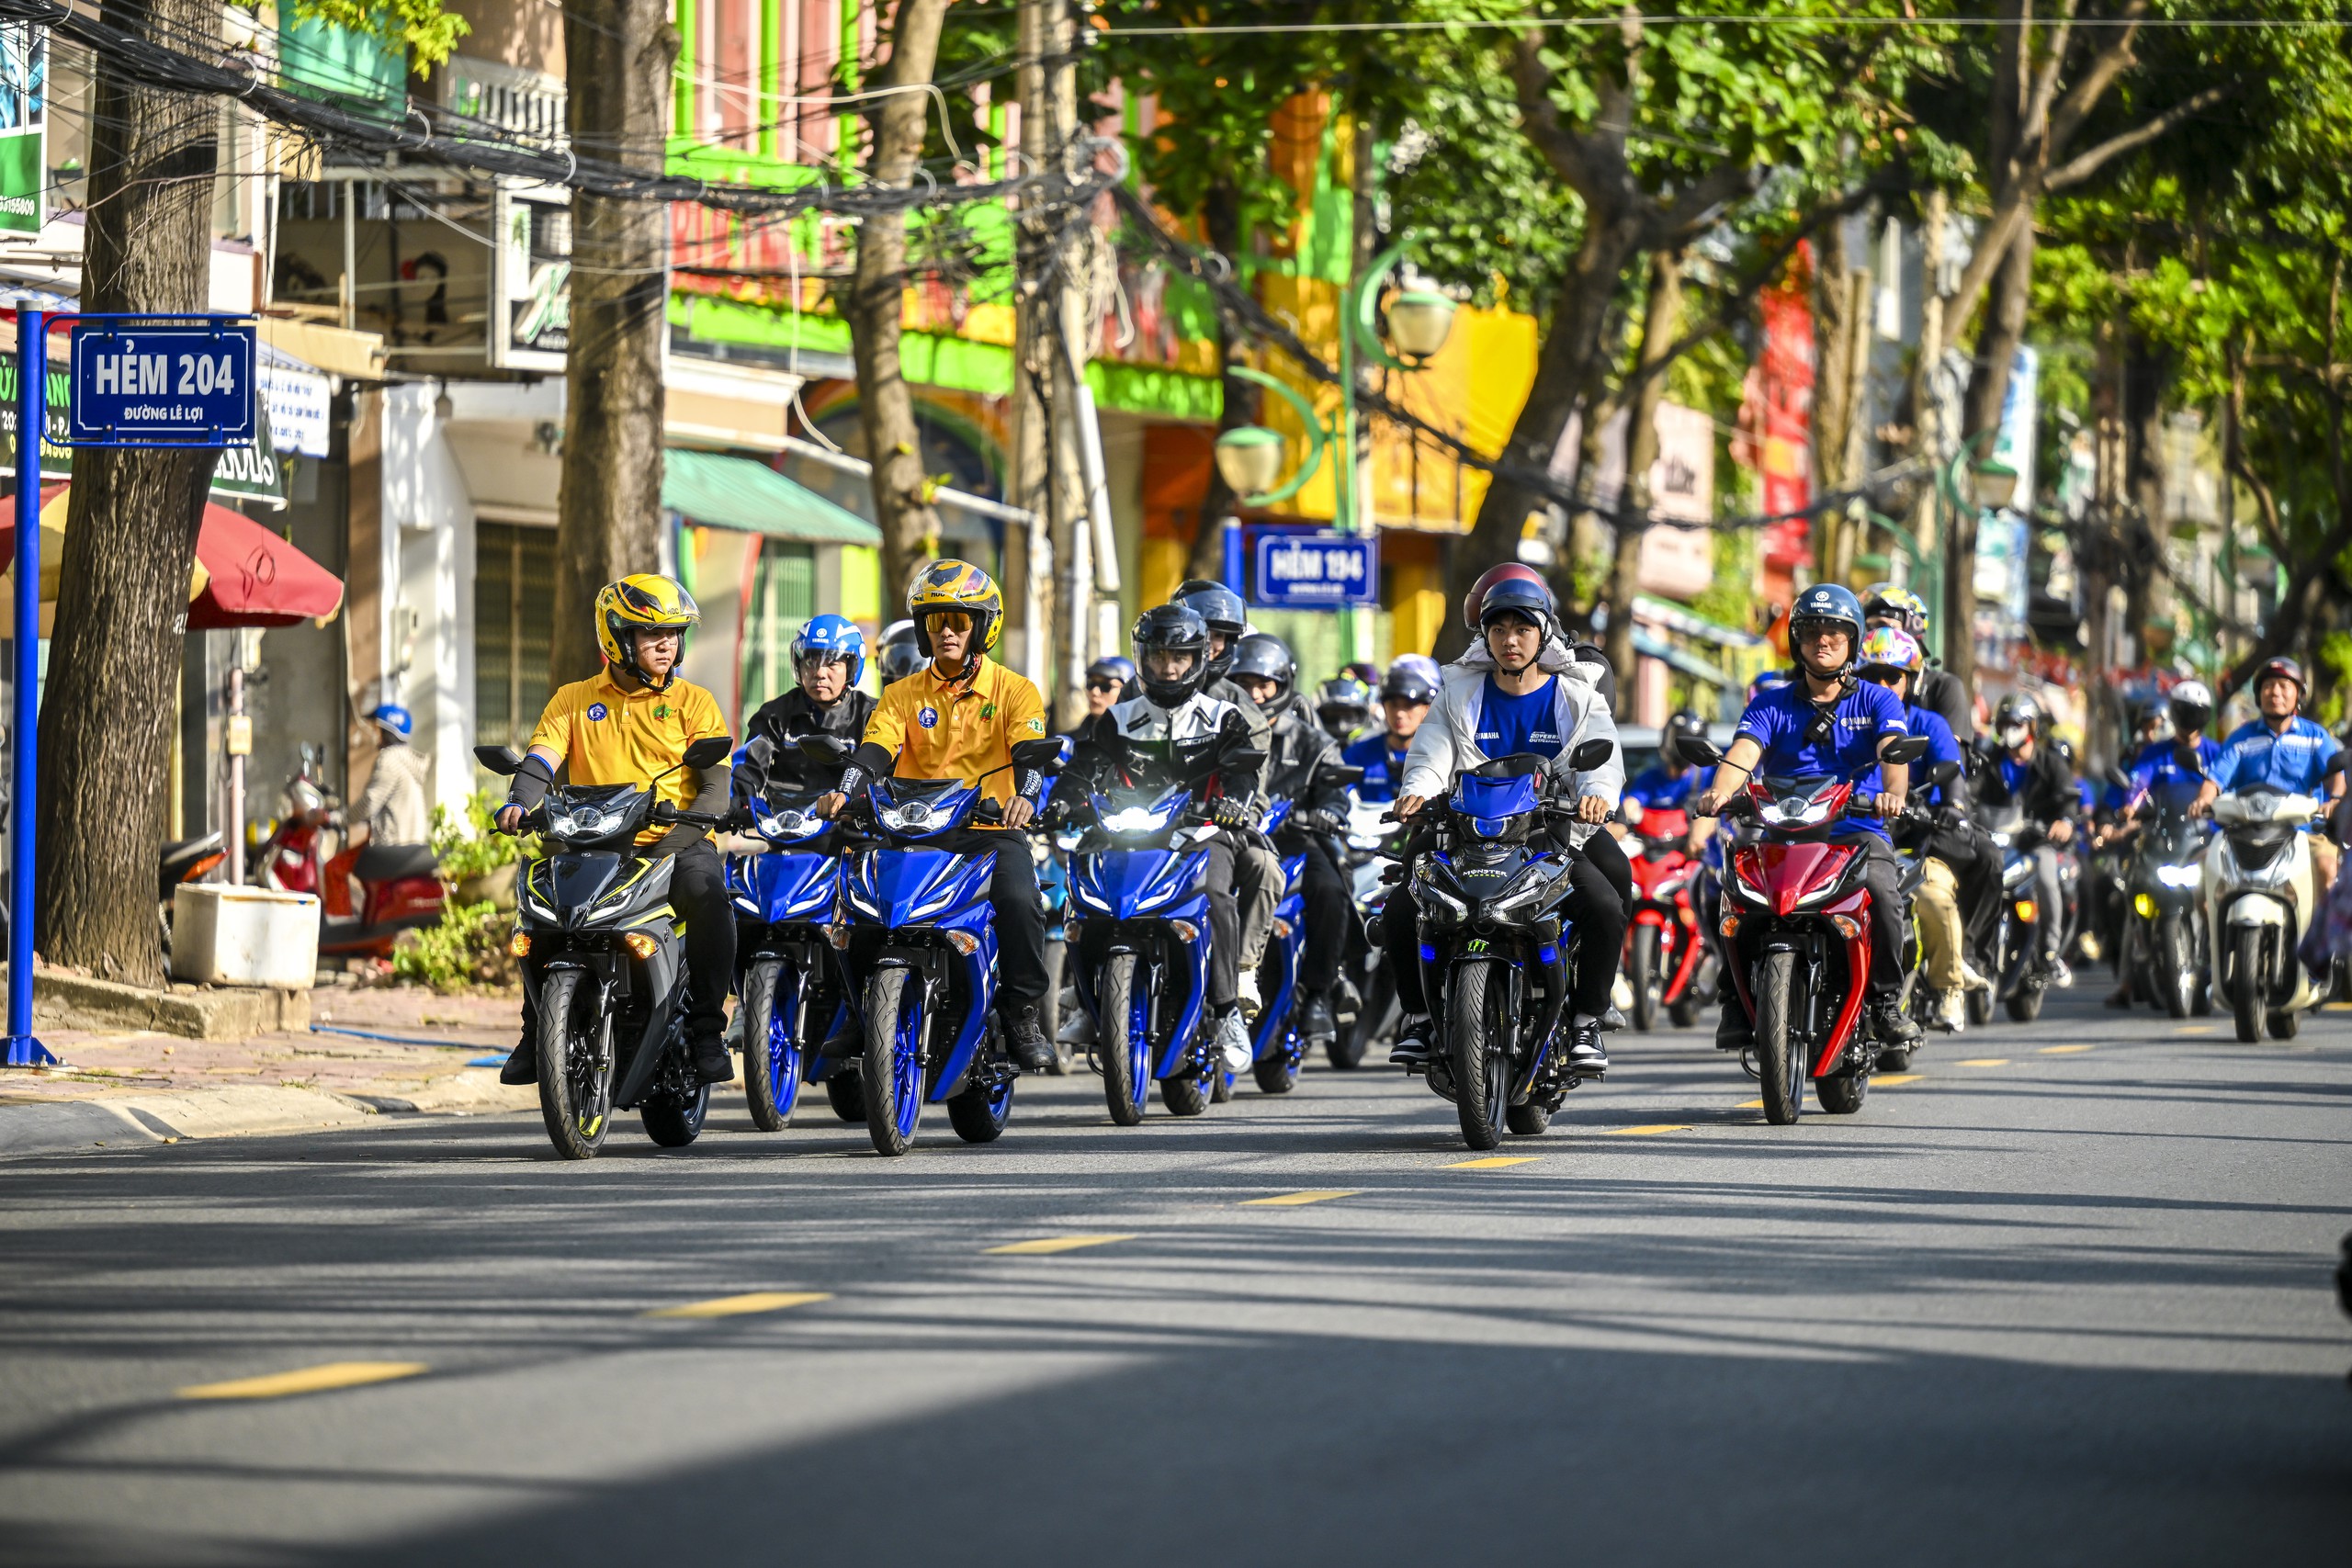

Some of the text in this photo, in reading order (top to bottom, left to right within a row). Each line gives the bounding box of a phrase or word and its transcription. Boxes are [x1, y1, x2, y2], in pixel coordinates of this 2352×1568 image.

[96, 339, 234, 396] HẺM 204
[124, 404, 203, 423] ĐƯỜNG LÊ LỢI
[1478, 731, 1499, 739] YAMAHA
[1463, 868, 1508, 877] MONSTER
